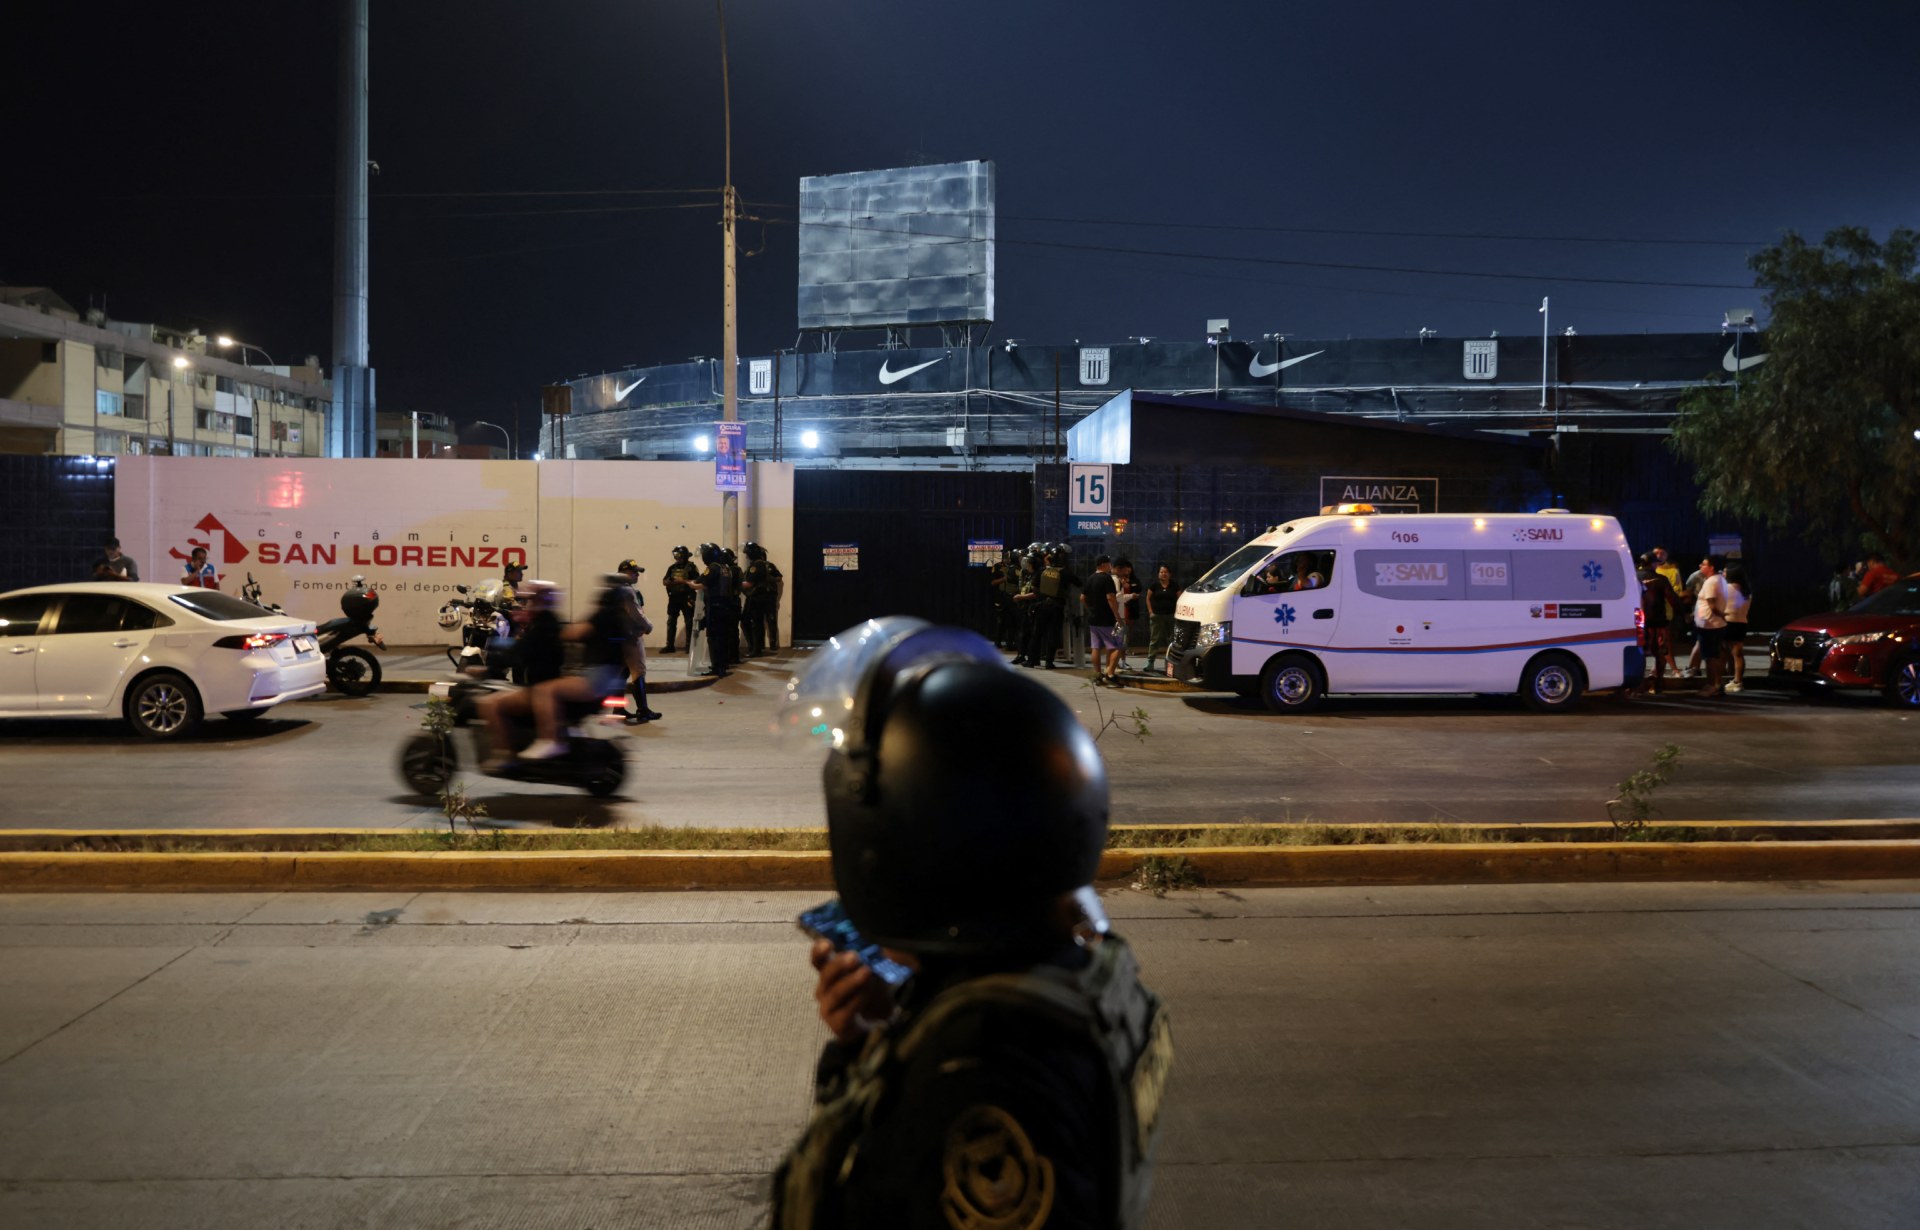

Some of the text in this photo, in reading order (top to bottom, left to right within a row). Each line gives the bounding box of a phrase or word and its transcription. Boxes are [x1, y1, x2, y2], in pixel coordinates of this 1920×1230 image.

[1075, 474, 1105, 504] 15
[1342, 485, 1419, 500] ALIANZA
[1077, 521, 1102, 530] PRENSA
[258, 528, 528, 543] cerámica
[1395, 533, 1419, 543] 106
[1527, 528, 1563, 540] SAMU
[258, 543, 526, 568] SAN LORENZO
[1395, 563, 1448, 581] SAMU
[1478, 566, 1506, 579] 106
[396, 582, 407, 592] el
[414, 582, 472, 594] depore
